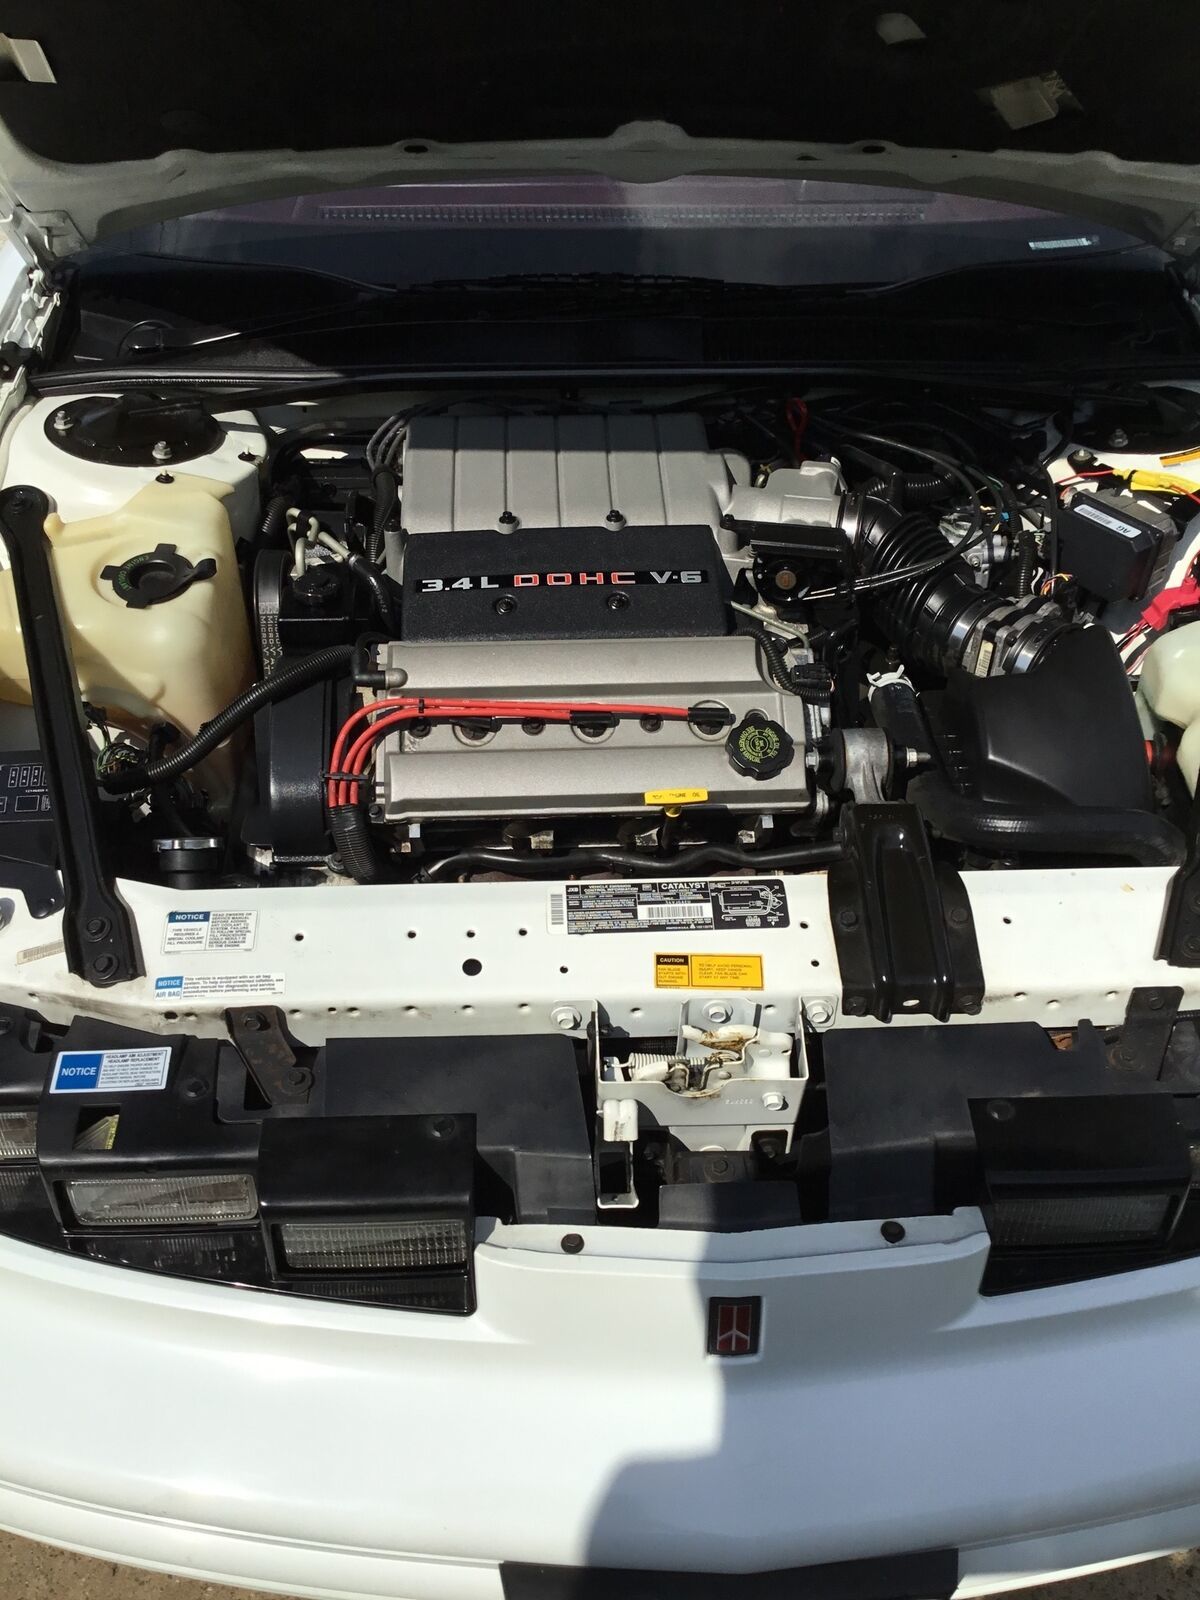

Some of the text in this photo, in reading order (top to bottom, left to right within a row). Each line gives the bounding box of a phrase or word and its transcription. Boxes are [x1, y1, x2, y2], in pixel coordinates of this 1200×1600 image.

[421, 570, 702, 592] 3.4L DOHC V-6
[61, 1067, 97, 1076] NOTICE
